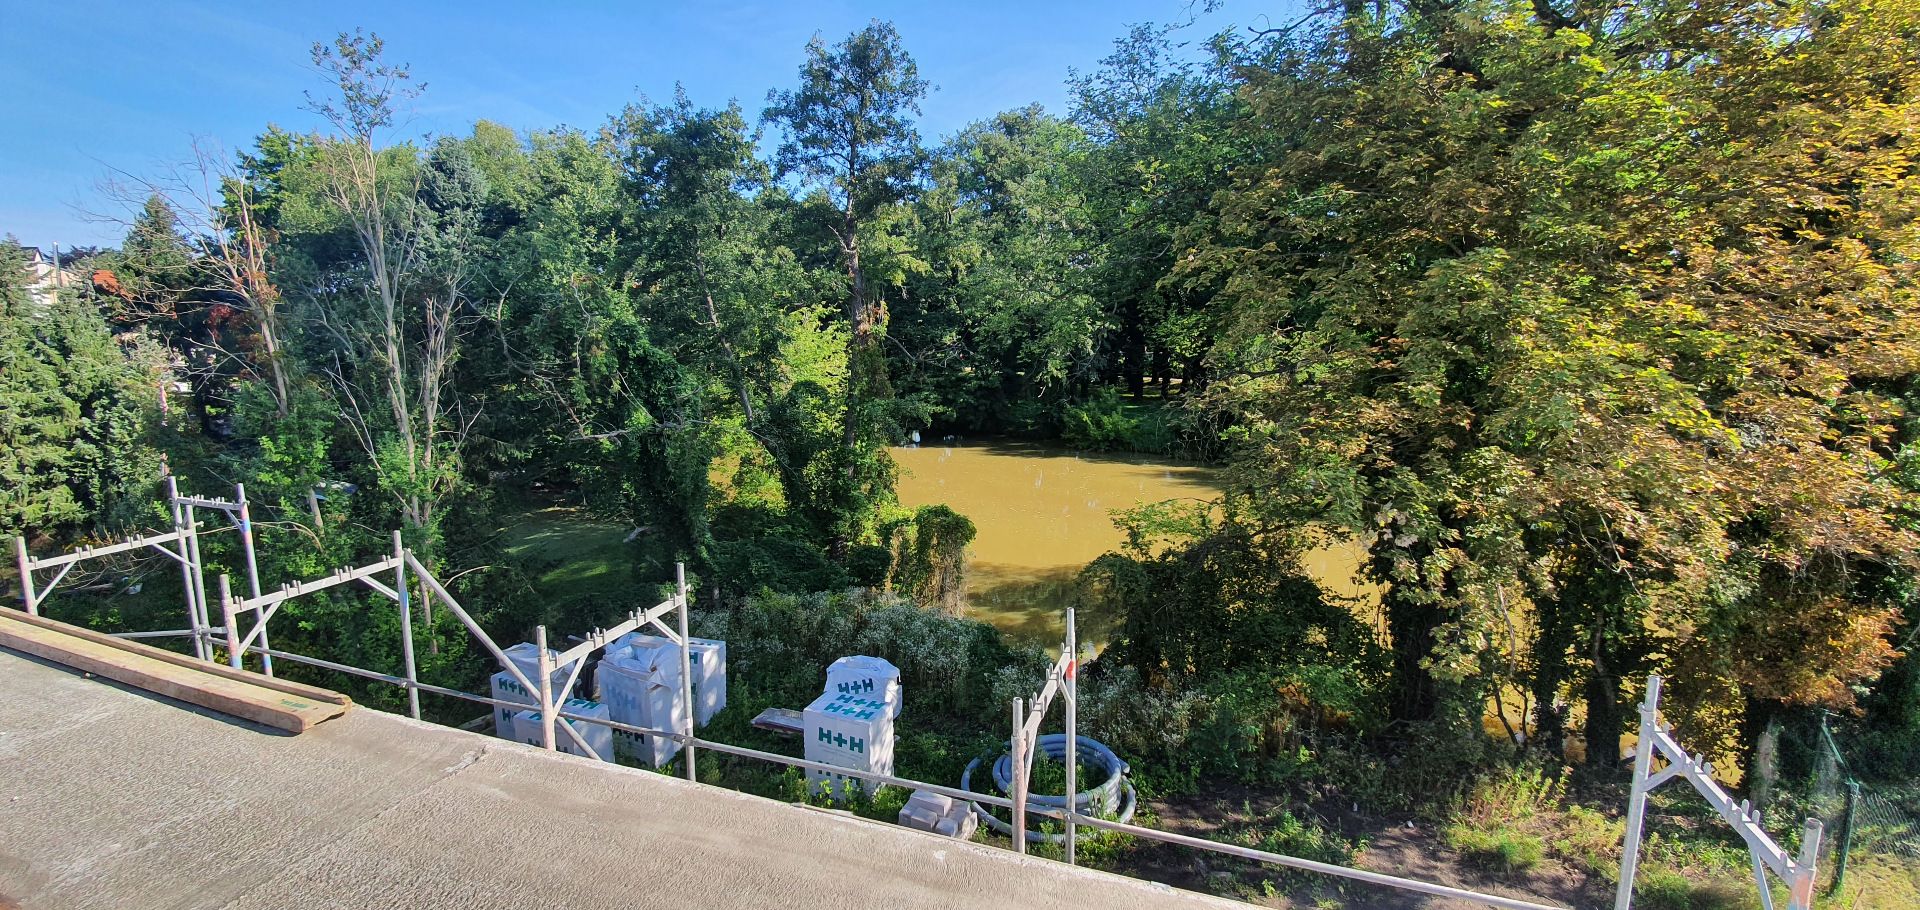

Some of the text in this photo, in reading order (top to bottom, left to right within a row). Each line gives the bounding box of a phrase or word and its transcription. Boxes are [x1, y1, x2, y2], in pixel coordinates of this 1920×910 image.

[838, 678, 874, 695] H+H
[836, 694, 887, 710] H+H
[823, 702, 875, 720] H+H
[818, 726, 864, 753] H+H
